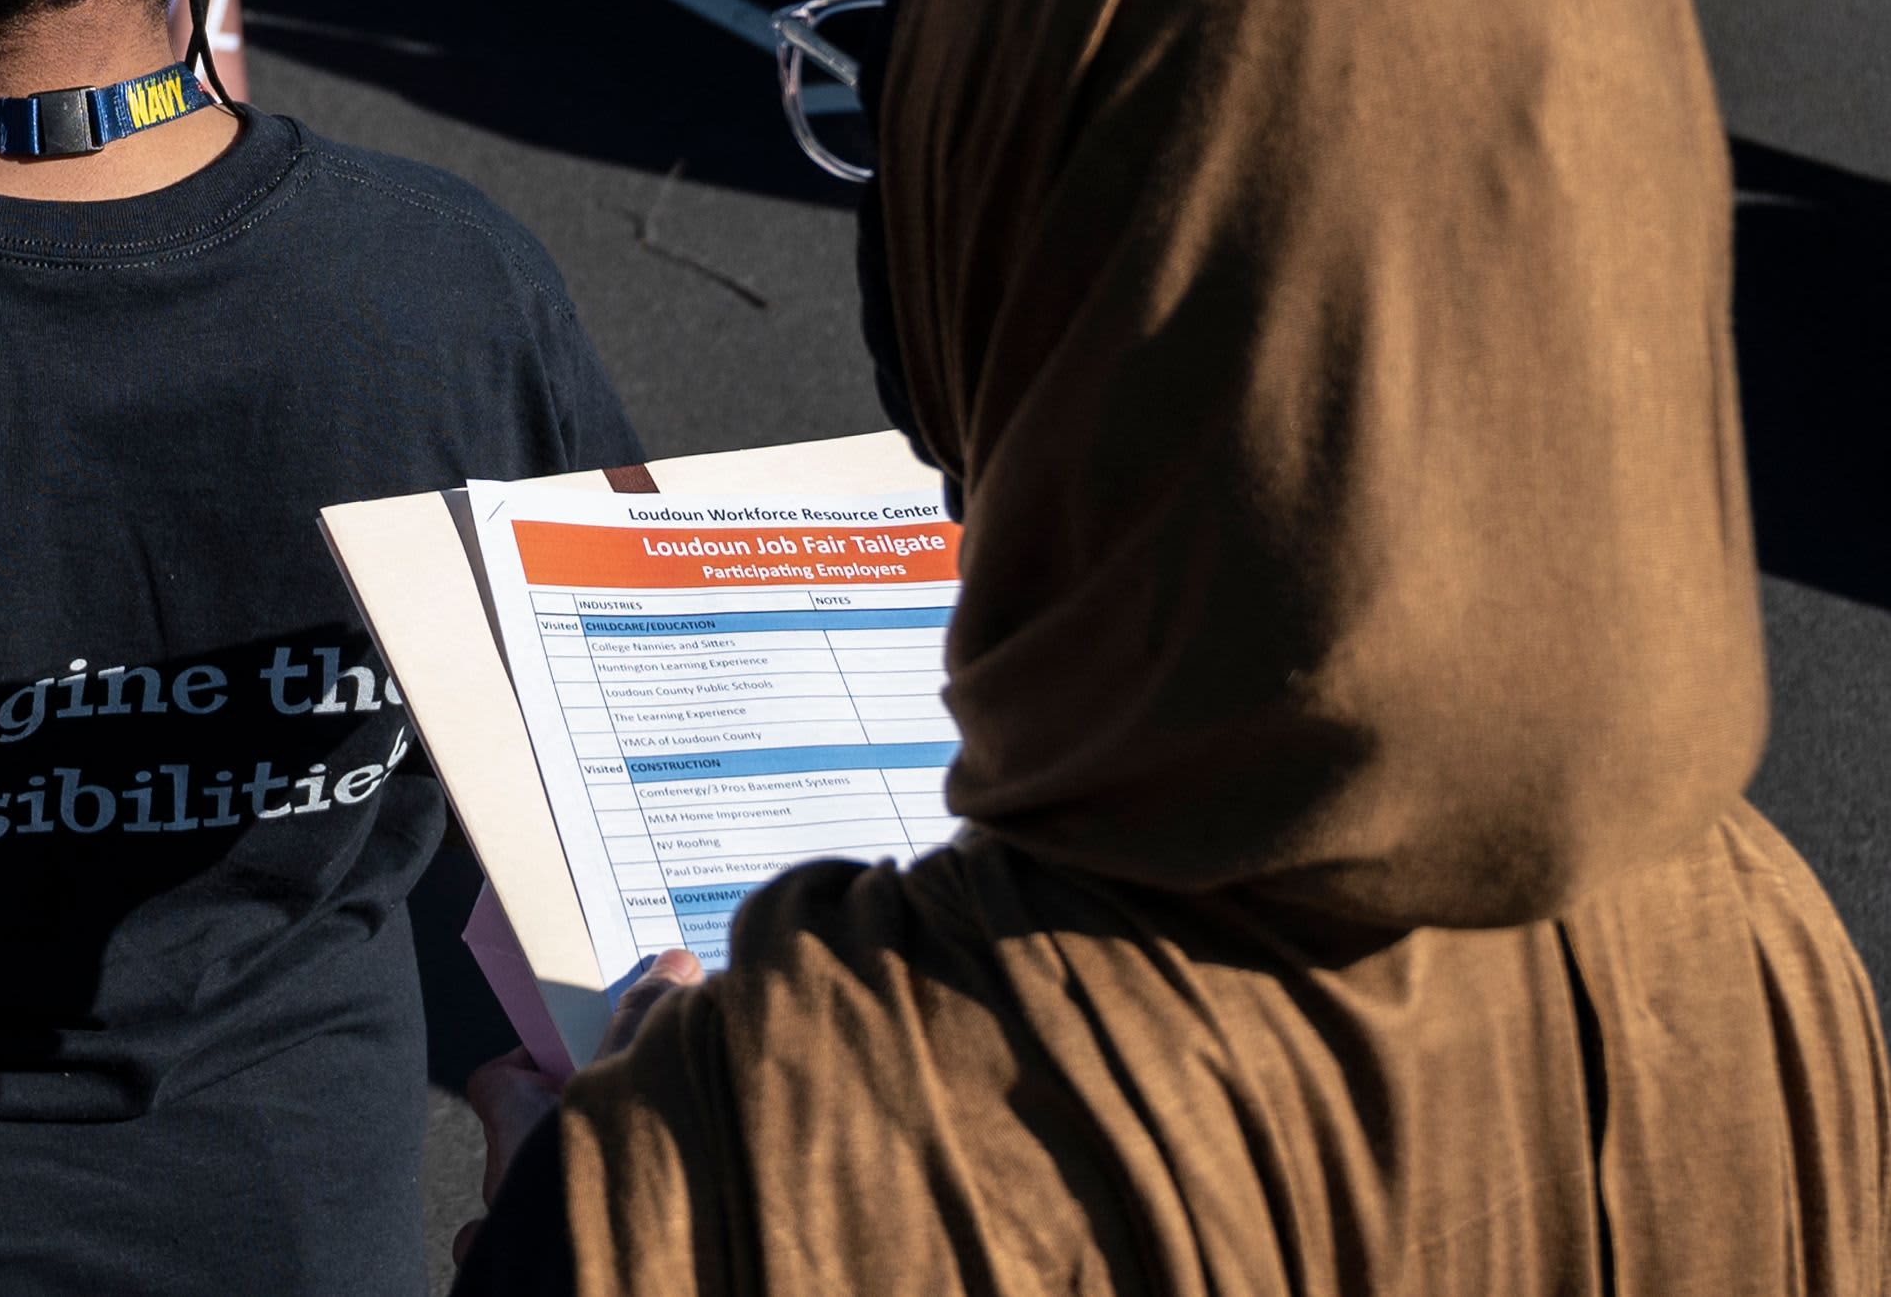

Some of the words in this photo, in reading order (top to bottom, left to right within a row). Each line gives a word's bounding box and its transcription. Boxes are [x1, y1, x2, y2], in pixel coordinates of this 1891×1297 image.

[128, 74, 186, 129] NAVY
[628, 507, 704, 522] Loudoun
[707, 506, 798, 522] Workforce
[801, 507, 879, 522] Resource
[882, 504, 940, 520] Center
[642, 536, 752, 557] Loudoun
[756, 535, 798, 555] Job
[801, 534, 847, 554] Fair
[850, 533, 946, 557] Tailgate
[702, 563, 815, 581] Participating
[815, 562, 907, 579] Employers
[579, 600, 643, 611] INDUSTRIES
[815, 596, 852, 606] NOTES
[541, 620, 579, 632] Visited
[585, 619, 717, 633] CHILDCARE/EDUCATION
[591, 641, 631, 654] College
[633, 640, 677, 652] Nannies
[679, 639, 699, 650] and
[701, 637, 737, 650] Sitters
[597, 661, 659, 674] Huntington
[661, 658, 709, 672] Learning
[709, 655, 769, 670] Experience
[605, 686, 654, 698] Loudoun
[656, 684, 695, 698] County
[697, 681, 730, 694] Public
[731, 679, 773, 691] Schools
[614, 712, 635, 723] The
[637, 710, 685, 723] Learning
[686, 706, 747, 720] Experience
[621, 736, 656, 748] YMCA
[658, 735, 669, 746] of
[671, 733, 721, 745] Loudoun
[723, 730, 763, 743] County
[584, 764, 624, 775] Visited
[630, 758, 722, 774] CONSTRUCTION
[721, 782, 747, 794] Pros
[748, 779, 803, 793] Basement
[805, 775, 851, 790] Systems
[648, 813, 678, 825] MLM
[680, 811, 714, 822] Home
[717, 806, 792, 821] Improvement
[656, 840, 674, 851] NV
[677, 837, 722, 850] Roofing
[665, 865, 691, 877] Paul
[693, 863, 724, 876] Davis
[626, 896, 668, 907] Visited
[674, 889, 748, 904] GOVERNME
[692, 948, 730, 959] oudo
